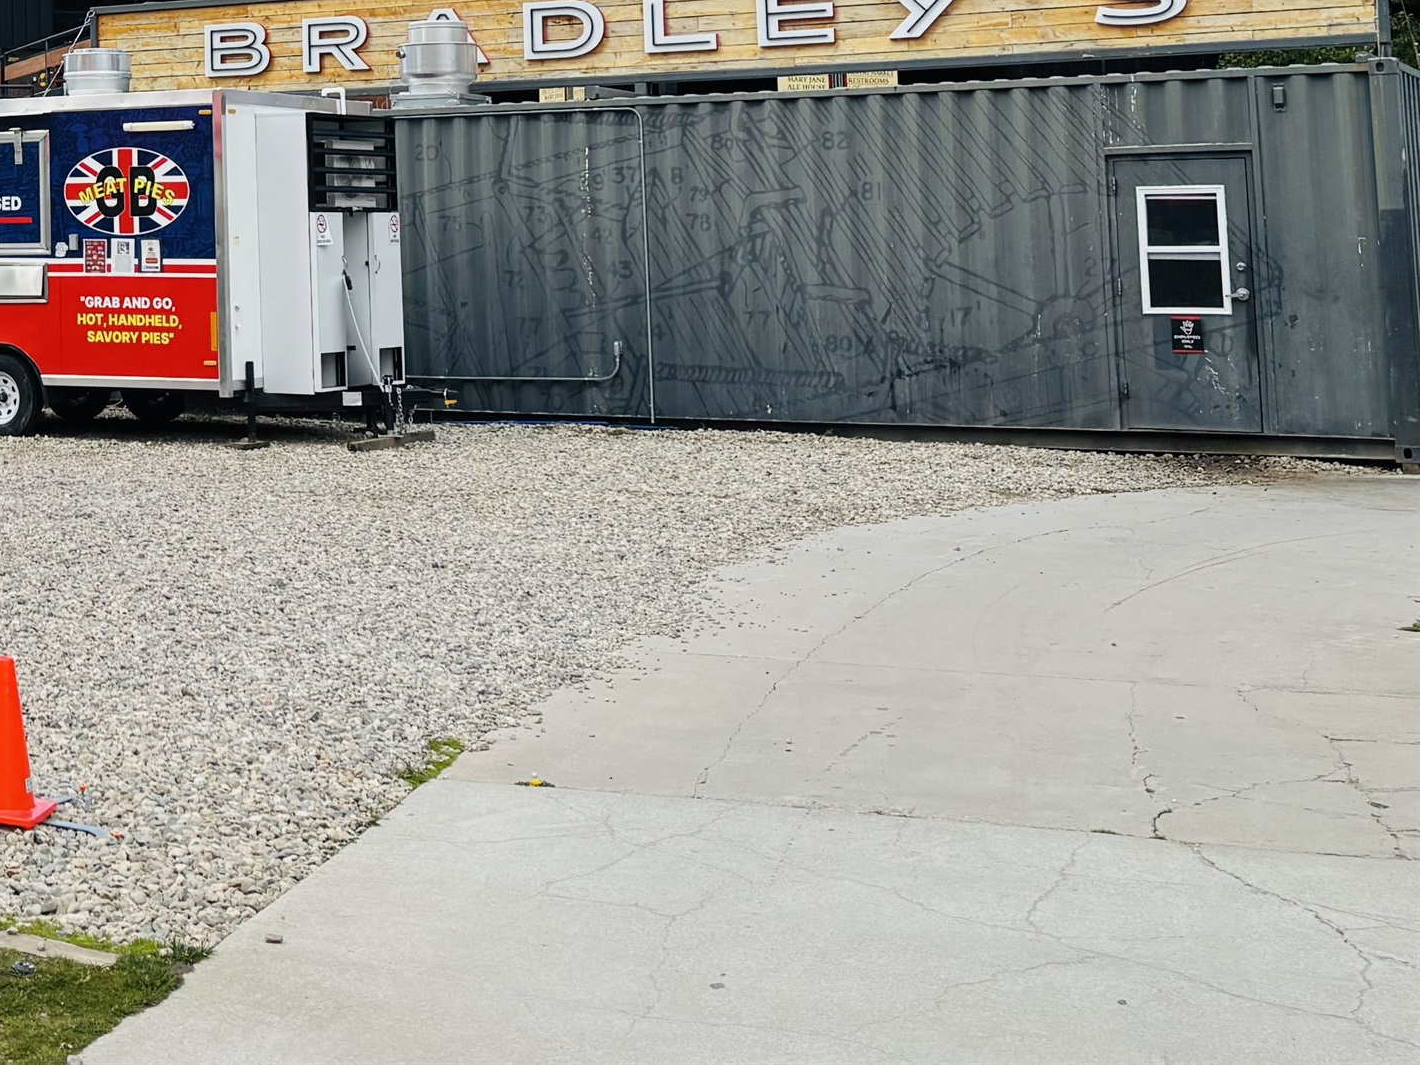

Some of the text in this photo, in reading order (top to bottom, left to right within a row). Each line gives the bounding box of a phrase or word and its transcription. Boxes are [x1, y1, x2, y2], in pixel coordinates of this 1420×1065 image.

[786, 75, 826, 83] MARY JANE
[848, 77, 890, 85] RESTROOMS
[78, 177, 176, 206] MEAT PIES
[80, 295, 176, 312] "GRAB AND GO,
[77, 313, 182, 330] HOT, HANDHELD,
[86, 331, 174, 345] SAVORY PIES"
